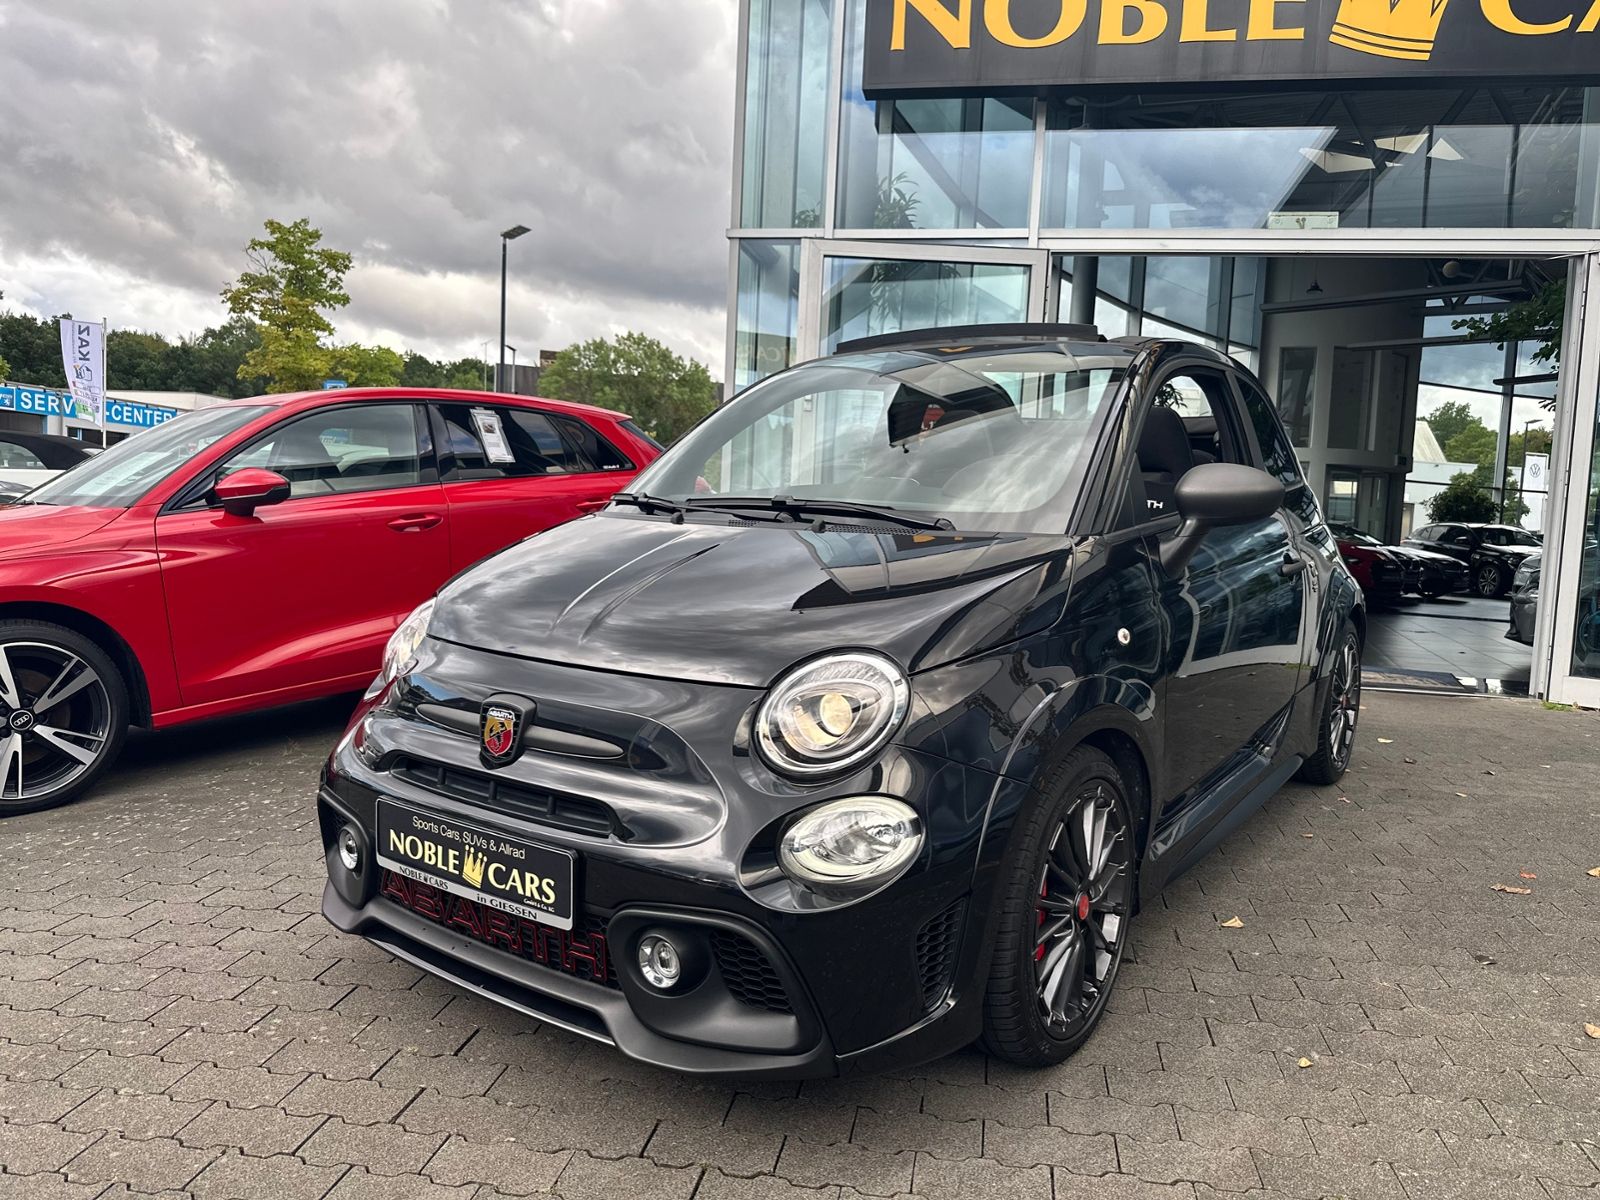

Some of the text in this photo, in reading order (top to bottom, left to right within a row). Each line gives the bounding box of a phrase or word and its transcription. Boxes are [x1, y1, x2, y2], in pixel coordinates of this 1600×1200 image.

[412, 815, 526, 859] Sports Cars, SUVs & Allrad
[389, 828, 556, 904] NOBLE CARS
[400, 866, 449, 890] NOBLE CARS
[477, 893, 538, 920] in GIESSEN
